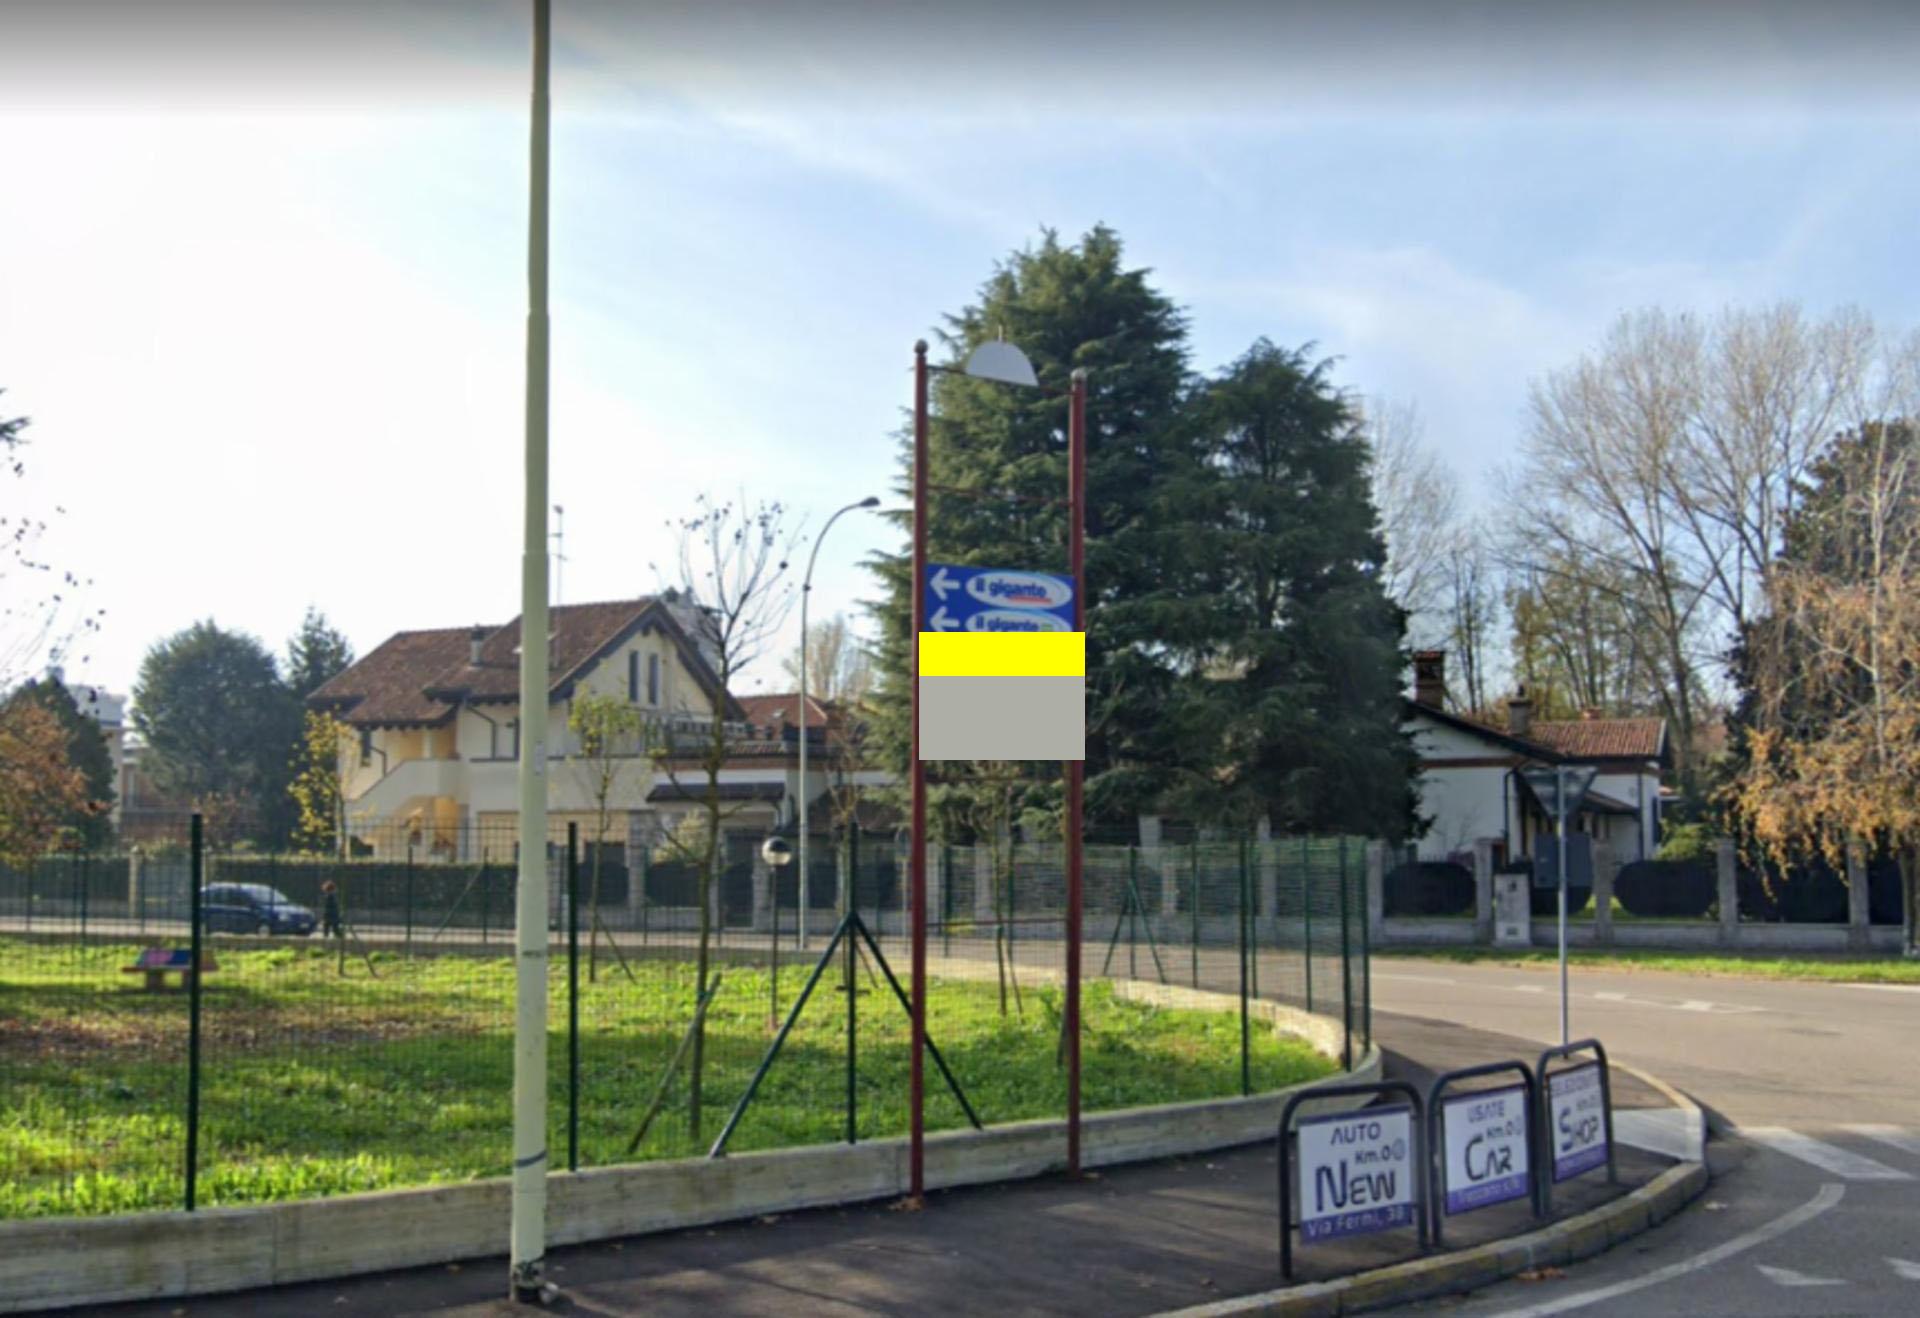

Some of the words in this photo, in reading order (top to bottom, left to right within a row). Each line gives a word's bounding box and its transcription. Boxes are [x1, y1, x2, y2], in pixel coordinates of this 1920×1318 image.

[989, 579, 1046, 598] gigante
[1330, 1122, 1381, 1145] AUTO
[1559, 1106, 1599, 1152] SHOP
[1464, 1133, 1513, 1181] CAR
[1316, 1161, 1396, 1211] NEW
